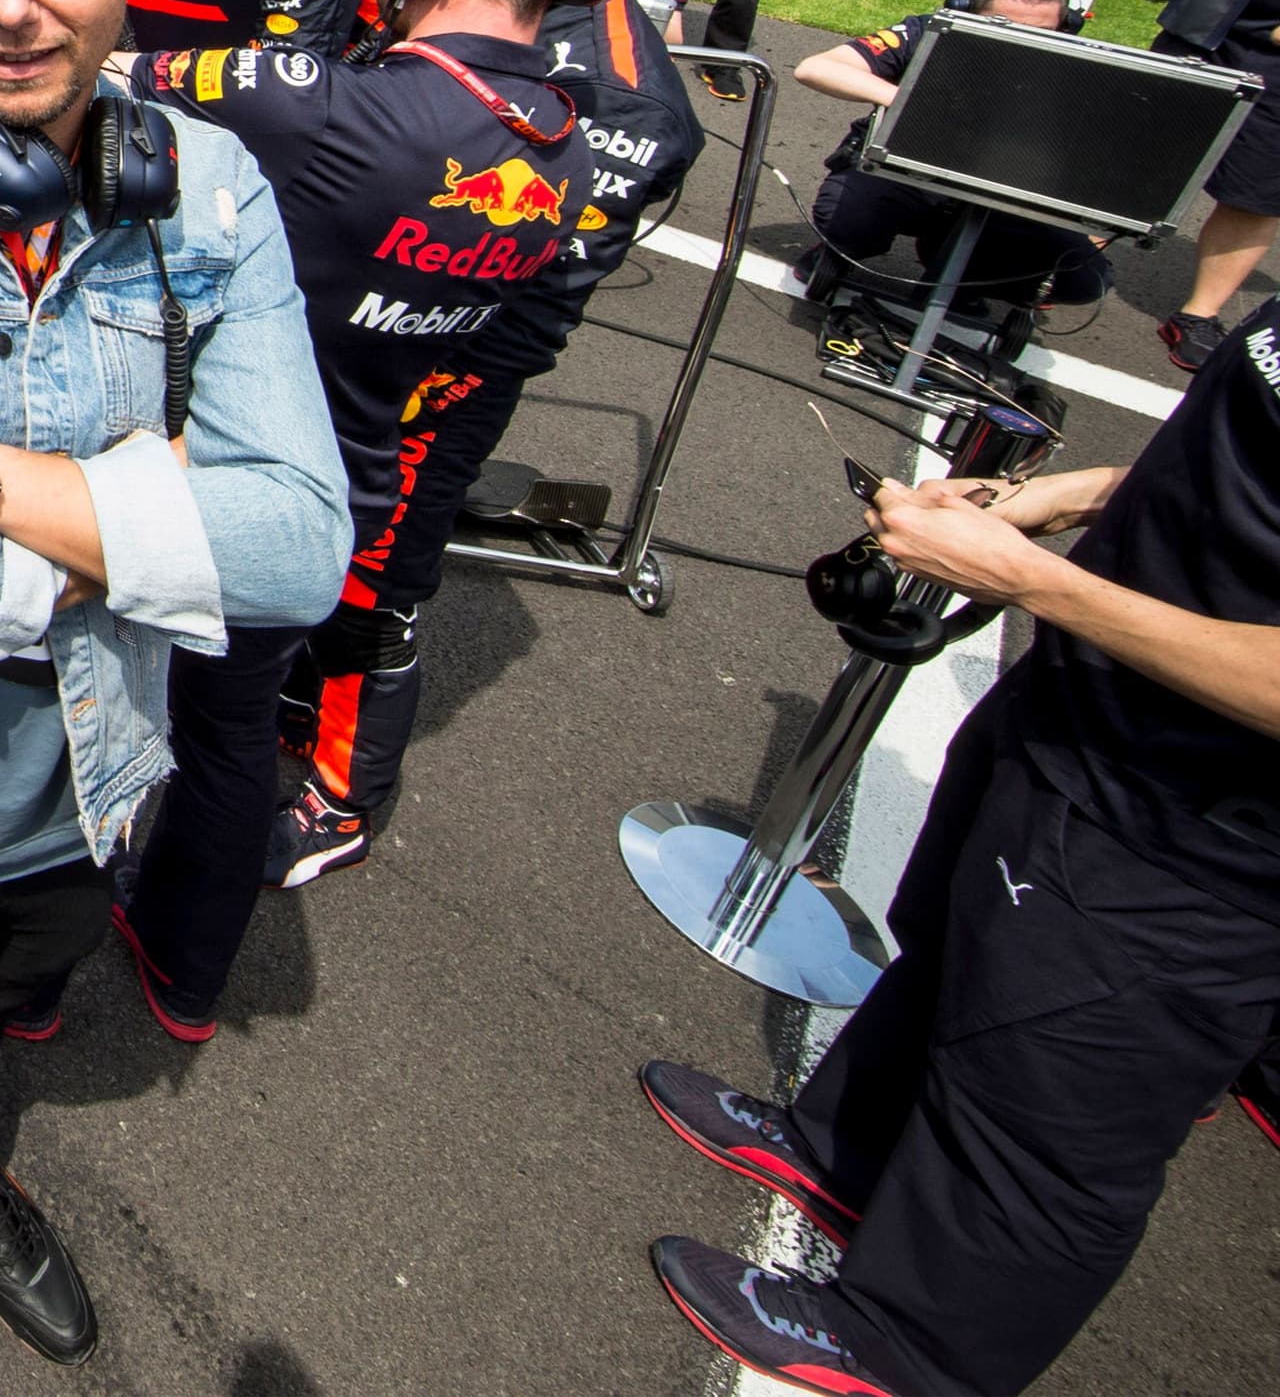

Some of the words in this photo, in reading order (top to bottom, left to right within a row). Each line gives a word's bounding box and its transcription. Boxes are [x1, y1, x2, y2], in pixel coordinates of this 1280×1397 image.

[373, 215, 492, 278] Red
[474, 236, 560, 281] Bull
[349, 291, 472, 335] Mobil
